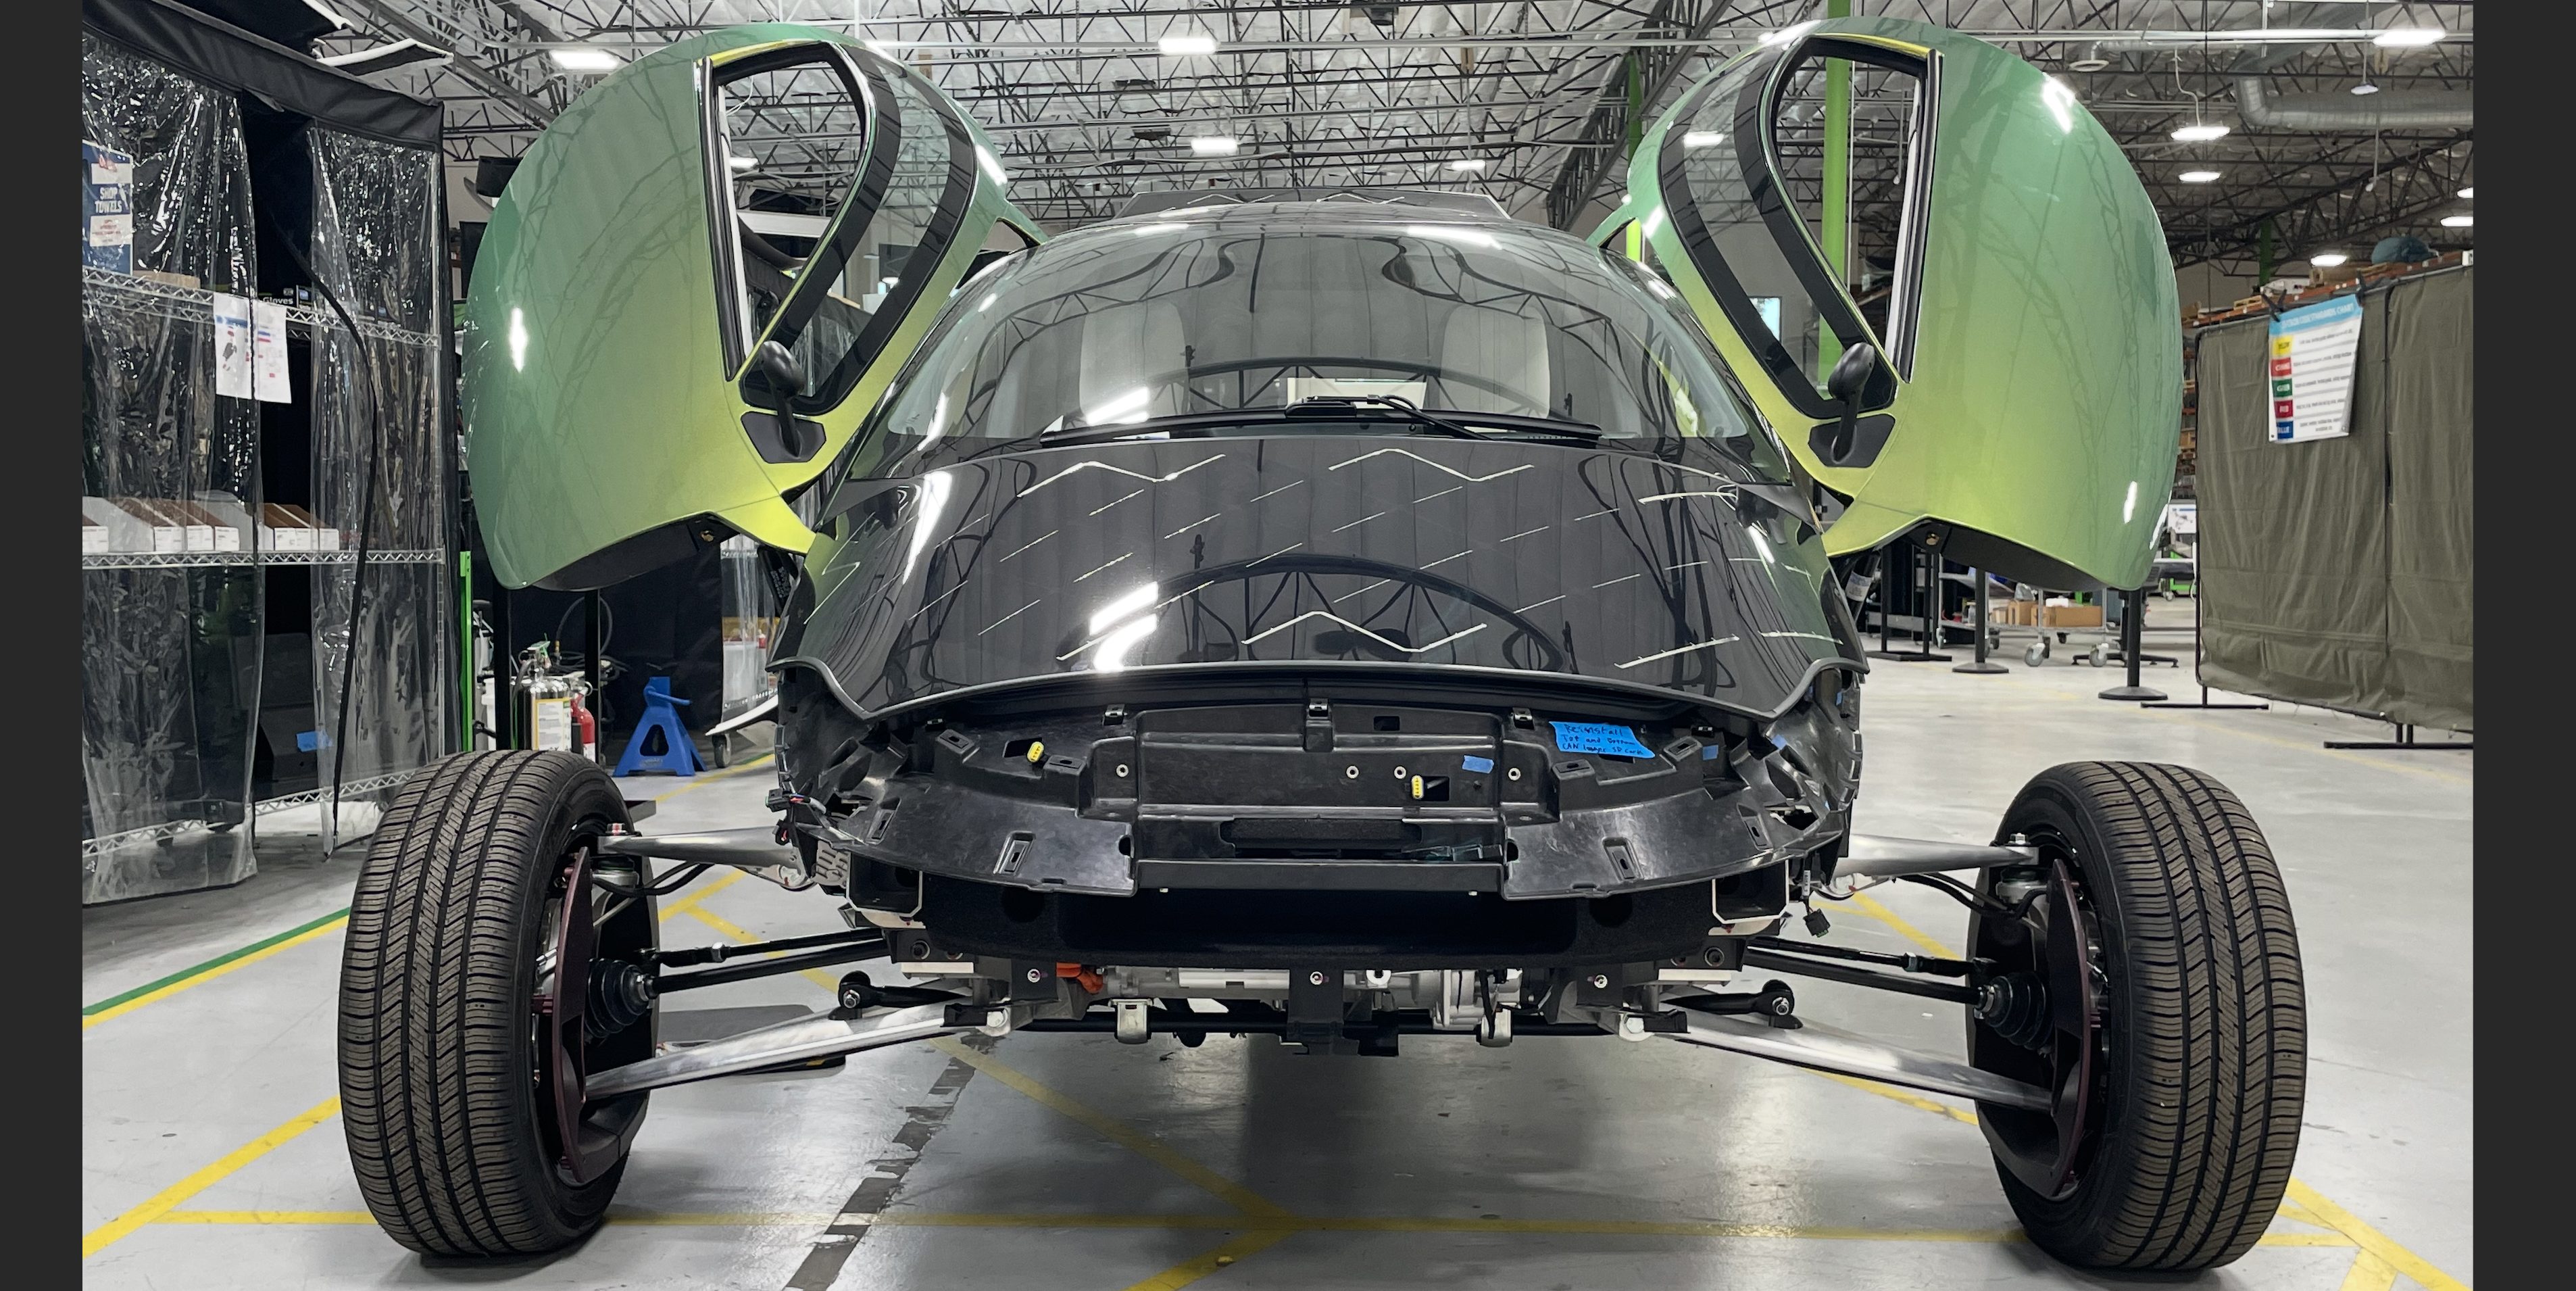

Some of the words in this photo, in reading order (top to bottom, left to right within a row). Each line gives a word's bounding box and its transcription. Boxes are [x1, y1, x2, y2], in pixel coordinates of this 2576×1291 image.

[99, 187, 118, 200] SHOP
[95, 200, 122, 214] TOWELS
[262, 297, 294, 305] Gloves
[1563, 724, 1623, 737] Reinstall
